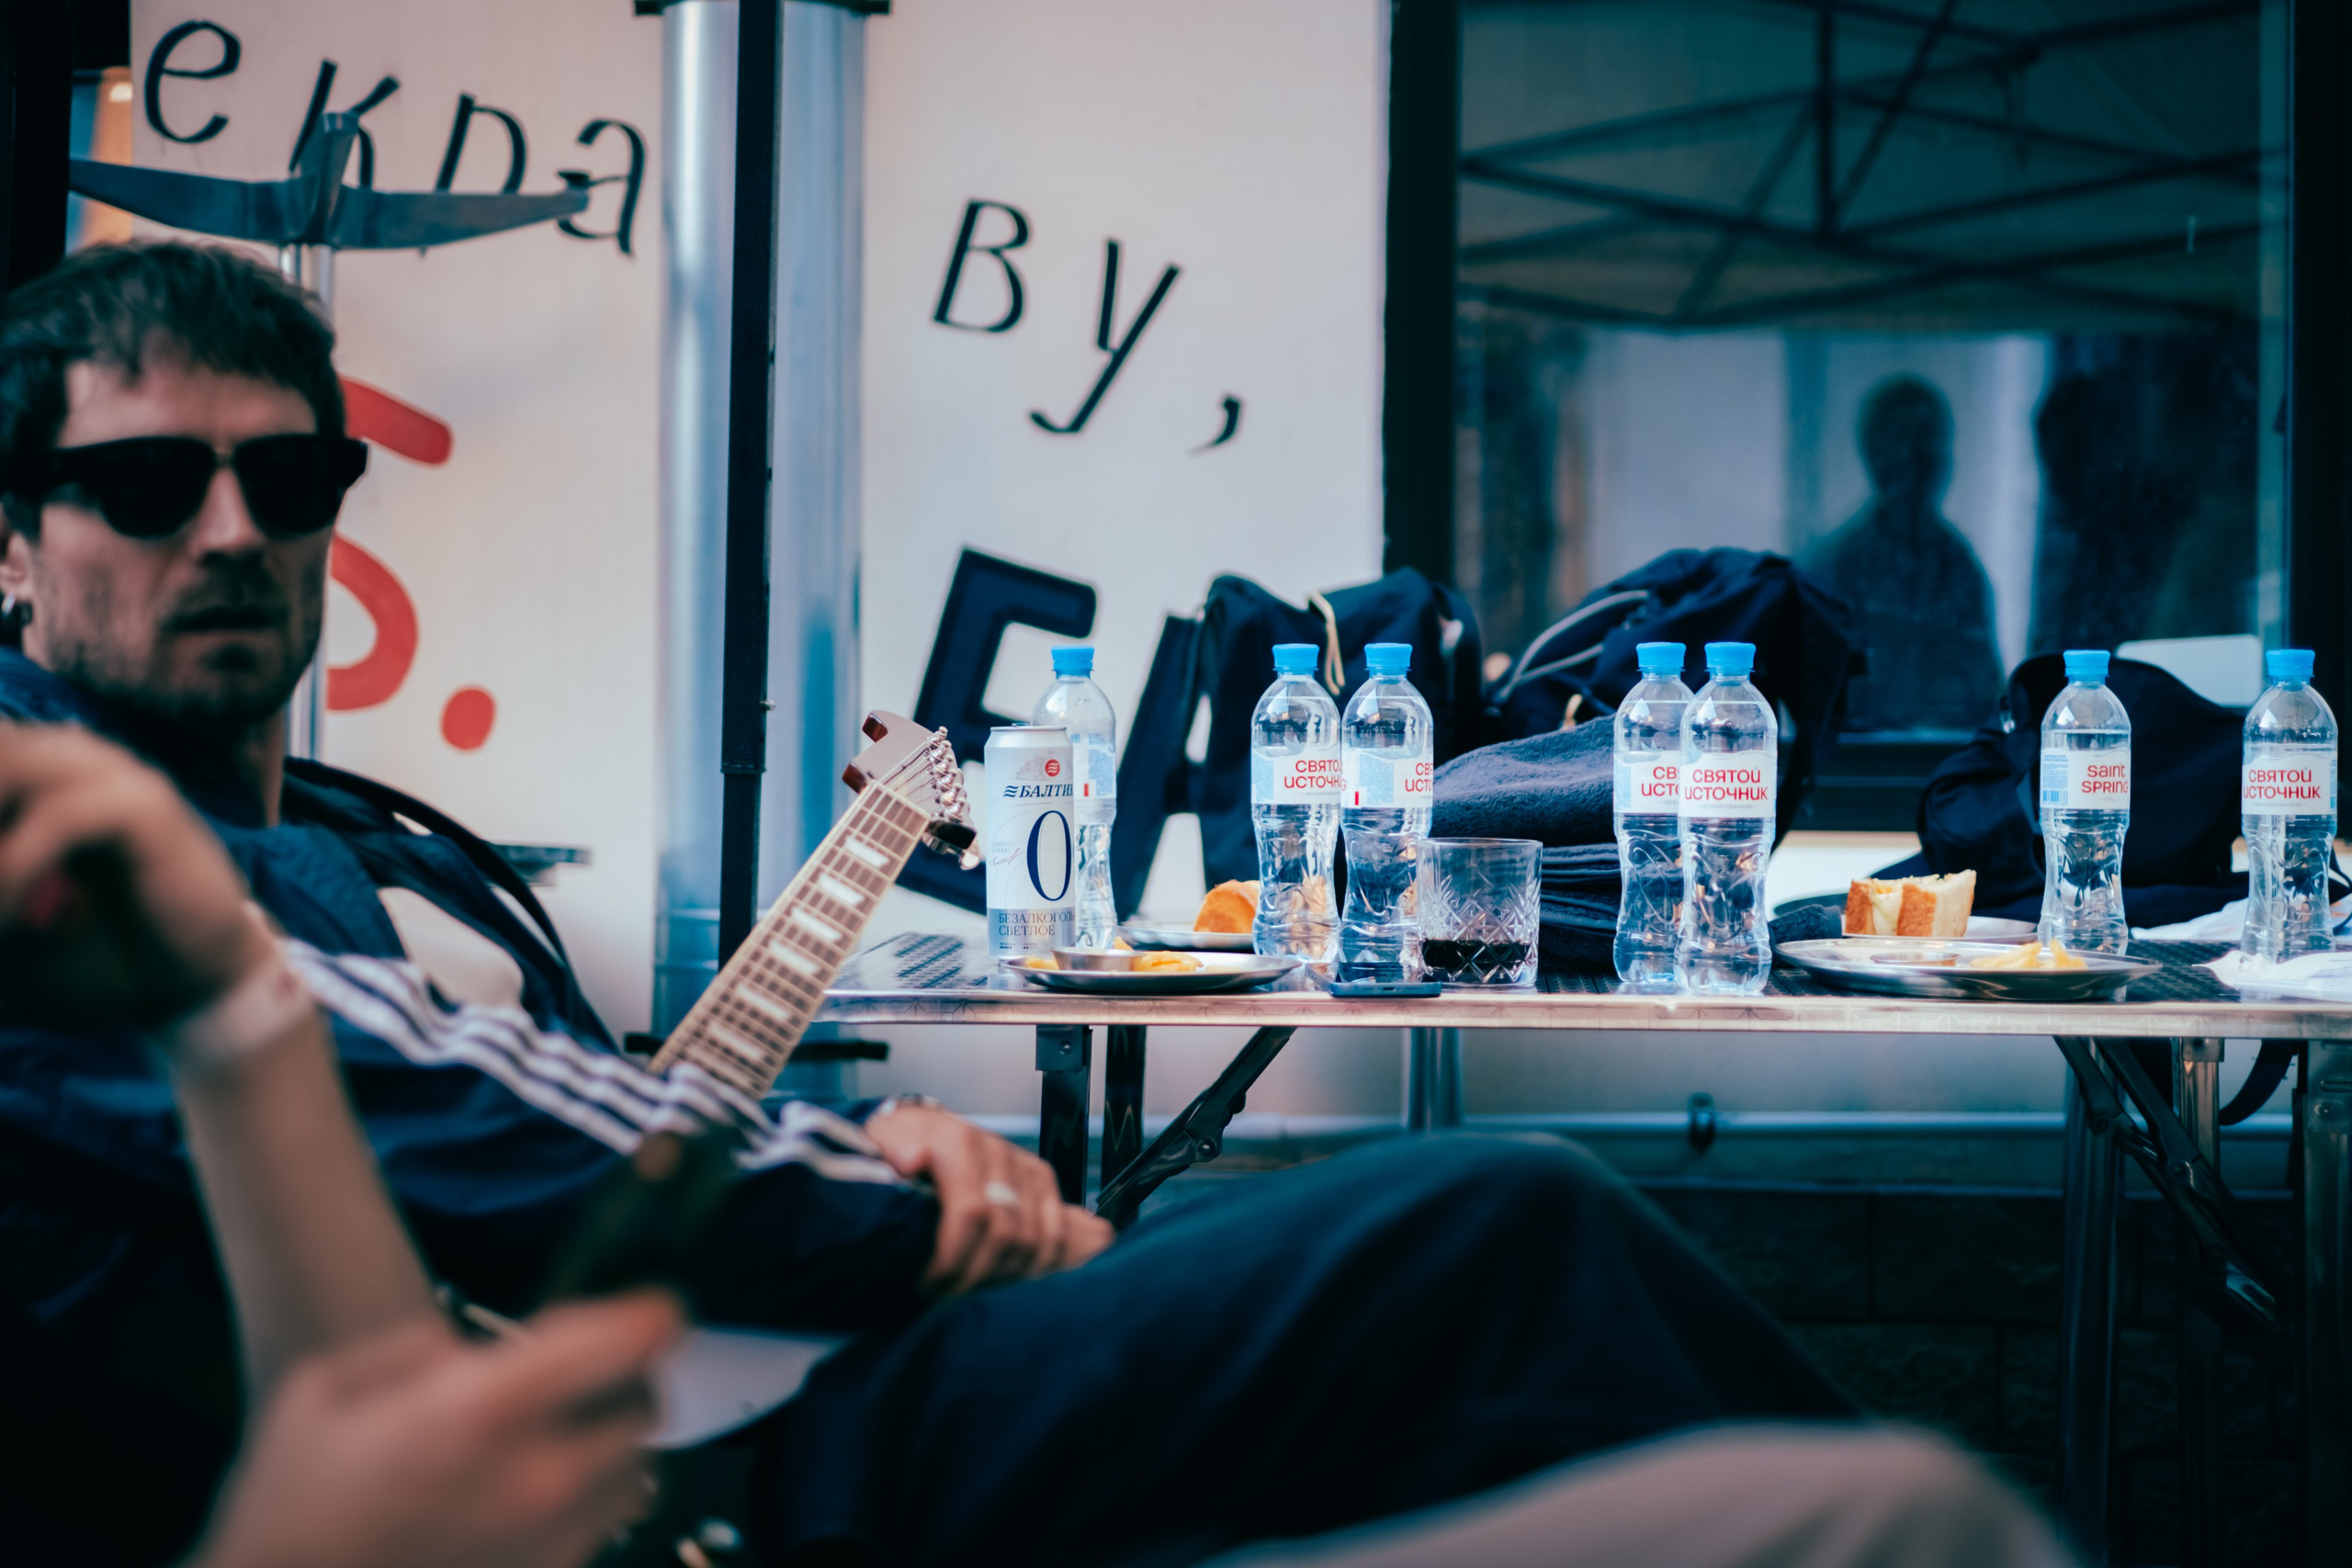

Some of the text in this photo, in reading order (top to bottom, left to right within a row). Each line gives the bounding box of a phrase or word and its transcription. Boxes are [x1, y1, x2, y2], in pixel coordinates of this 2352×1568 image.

[1295, 759, 1342, 773] СВЯТО
[1653, 766, 1679, 780] СВ
[1283, 775, 1342, 788] ИСТОЧН
[1684, 786, 1769, 800] ИСТОЧНИК
[2244, 785, 2322, 799] ИСТОЧНИК
[999, 925, 1056, 936] СВЕТЛОЕ
